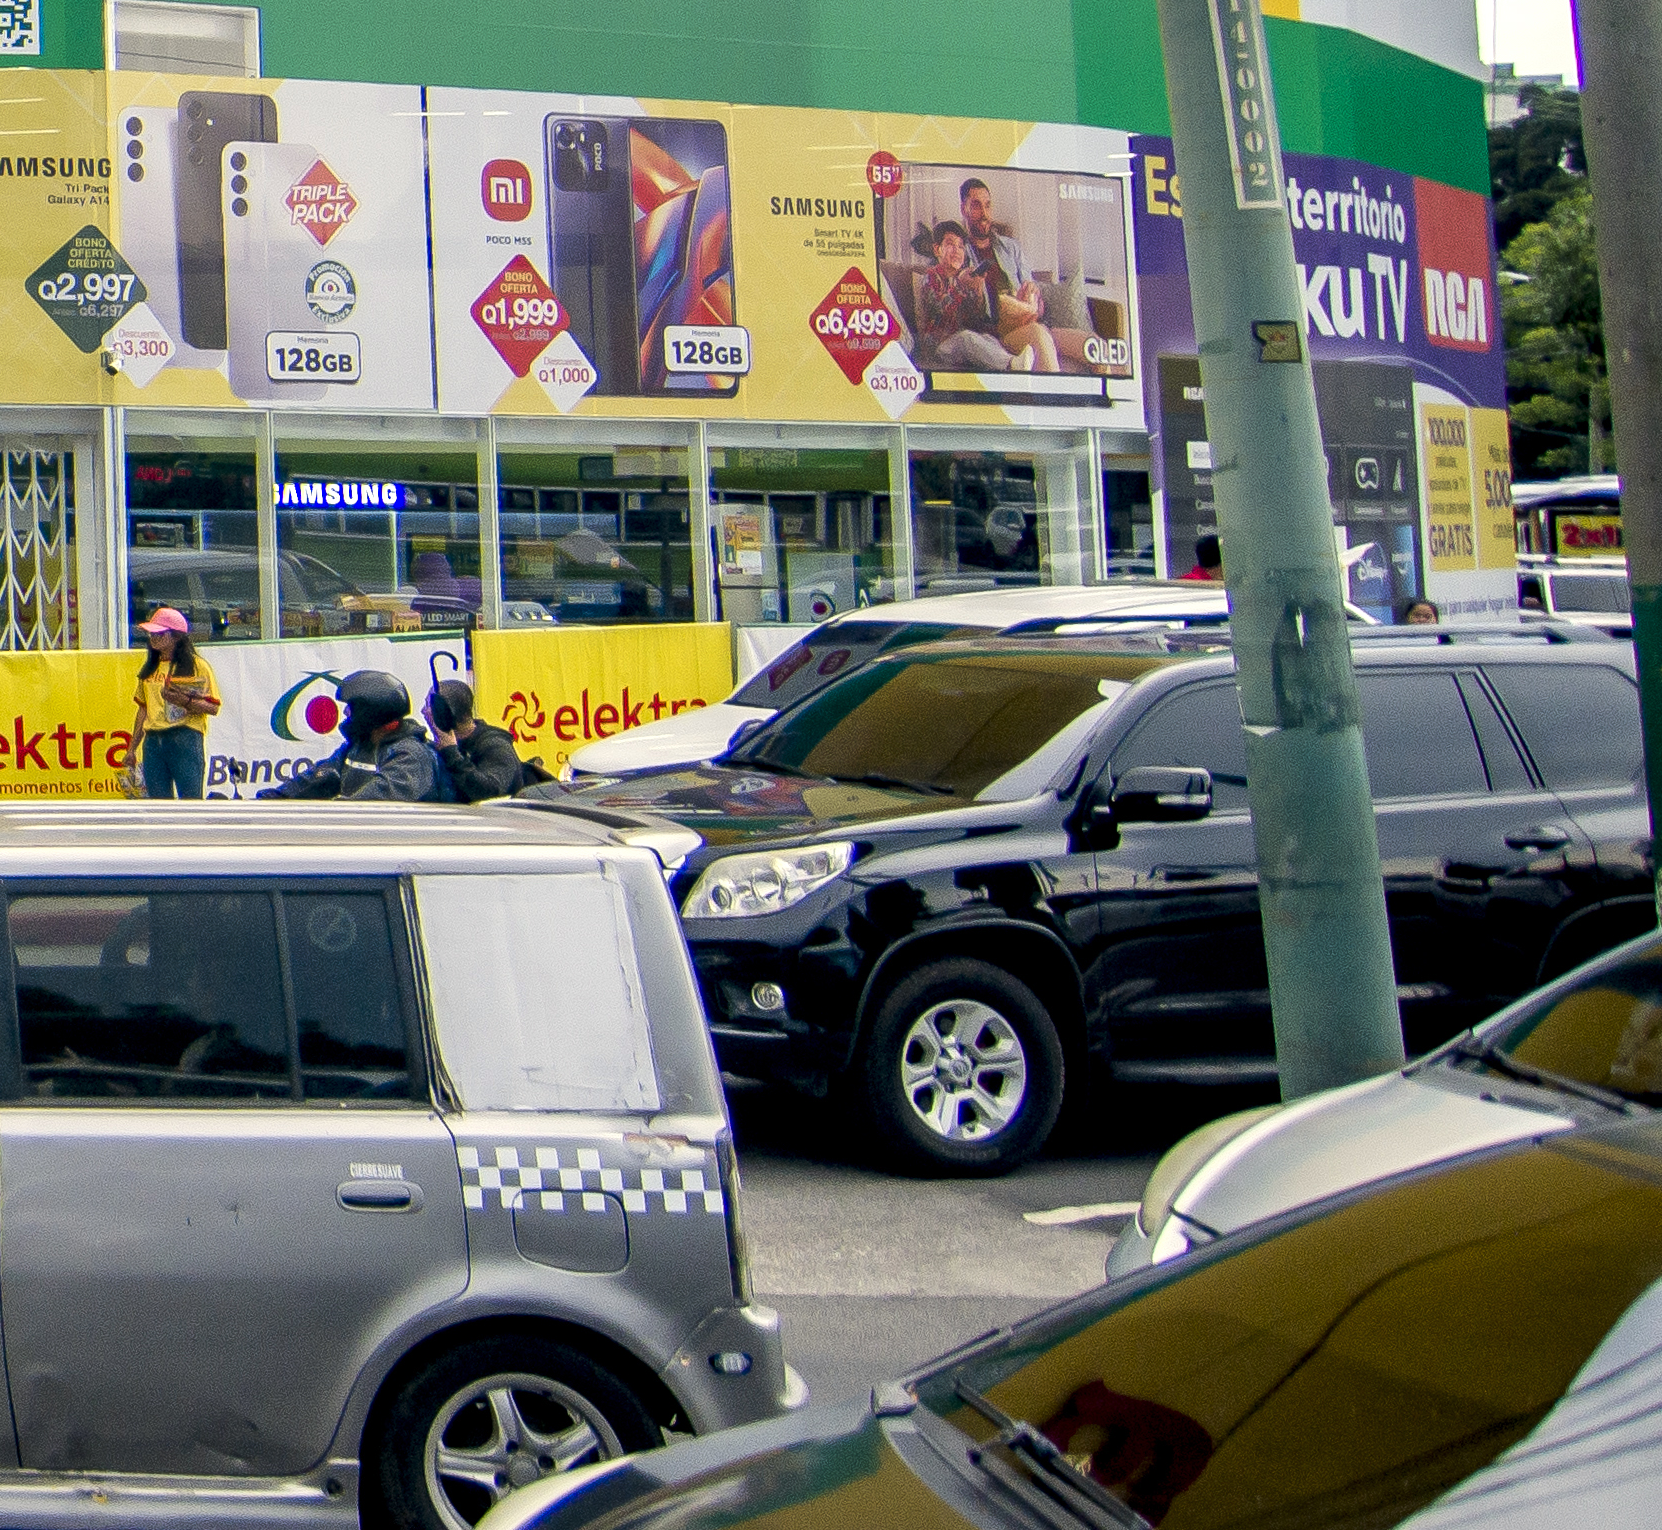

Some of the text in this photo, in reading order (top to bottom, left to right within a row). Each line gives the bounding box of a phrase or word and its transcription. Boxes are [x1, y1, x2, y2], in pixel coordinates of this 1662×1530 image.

[65, 183, 109, 194] Tri Pack
[290, 182, 348, 202] TRIPLE
[1058, 182, 1115, 203] SAMSUNG
[47, 194, 110, 208] Galaxy A14
[770, 196, 866, 219] SAMSUNG
[1286, 175, 1406, 244] territorio
[292, 202, 350, 225] PACK
[74, 237, 108, 247] BONO
[485, 235, 512, 245] POCO
[68, 247, 113, 258] OFERTA
[499, 283, 538, 294] OFERTA
[503, 272, 533, 282] BONO
[37, 272, 136, 306] Q2,997
[1368, 254, 1409, 344] TV
[78, 304, 124, 318] Q6,297
[481, 298, 559, 330] Q1,999
[1423, 268, 1488, 344] RCA
[815, 309, 890, 339] Q6,499
[275, 347, 353, 373] 128GB
[671, 340, 744, 366] 128GB
[1083, 337, 1129, 367] QLED
[538, 368, 591, 385] Q1,000
[870, 374, 918, 392] Q3,100
[273, 482, 398, 507] SAMSUNG
[1429, 524, 1474, 559] GRATIS
